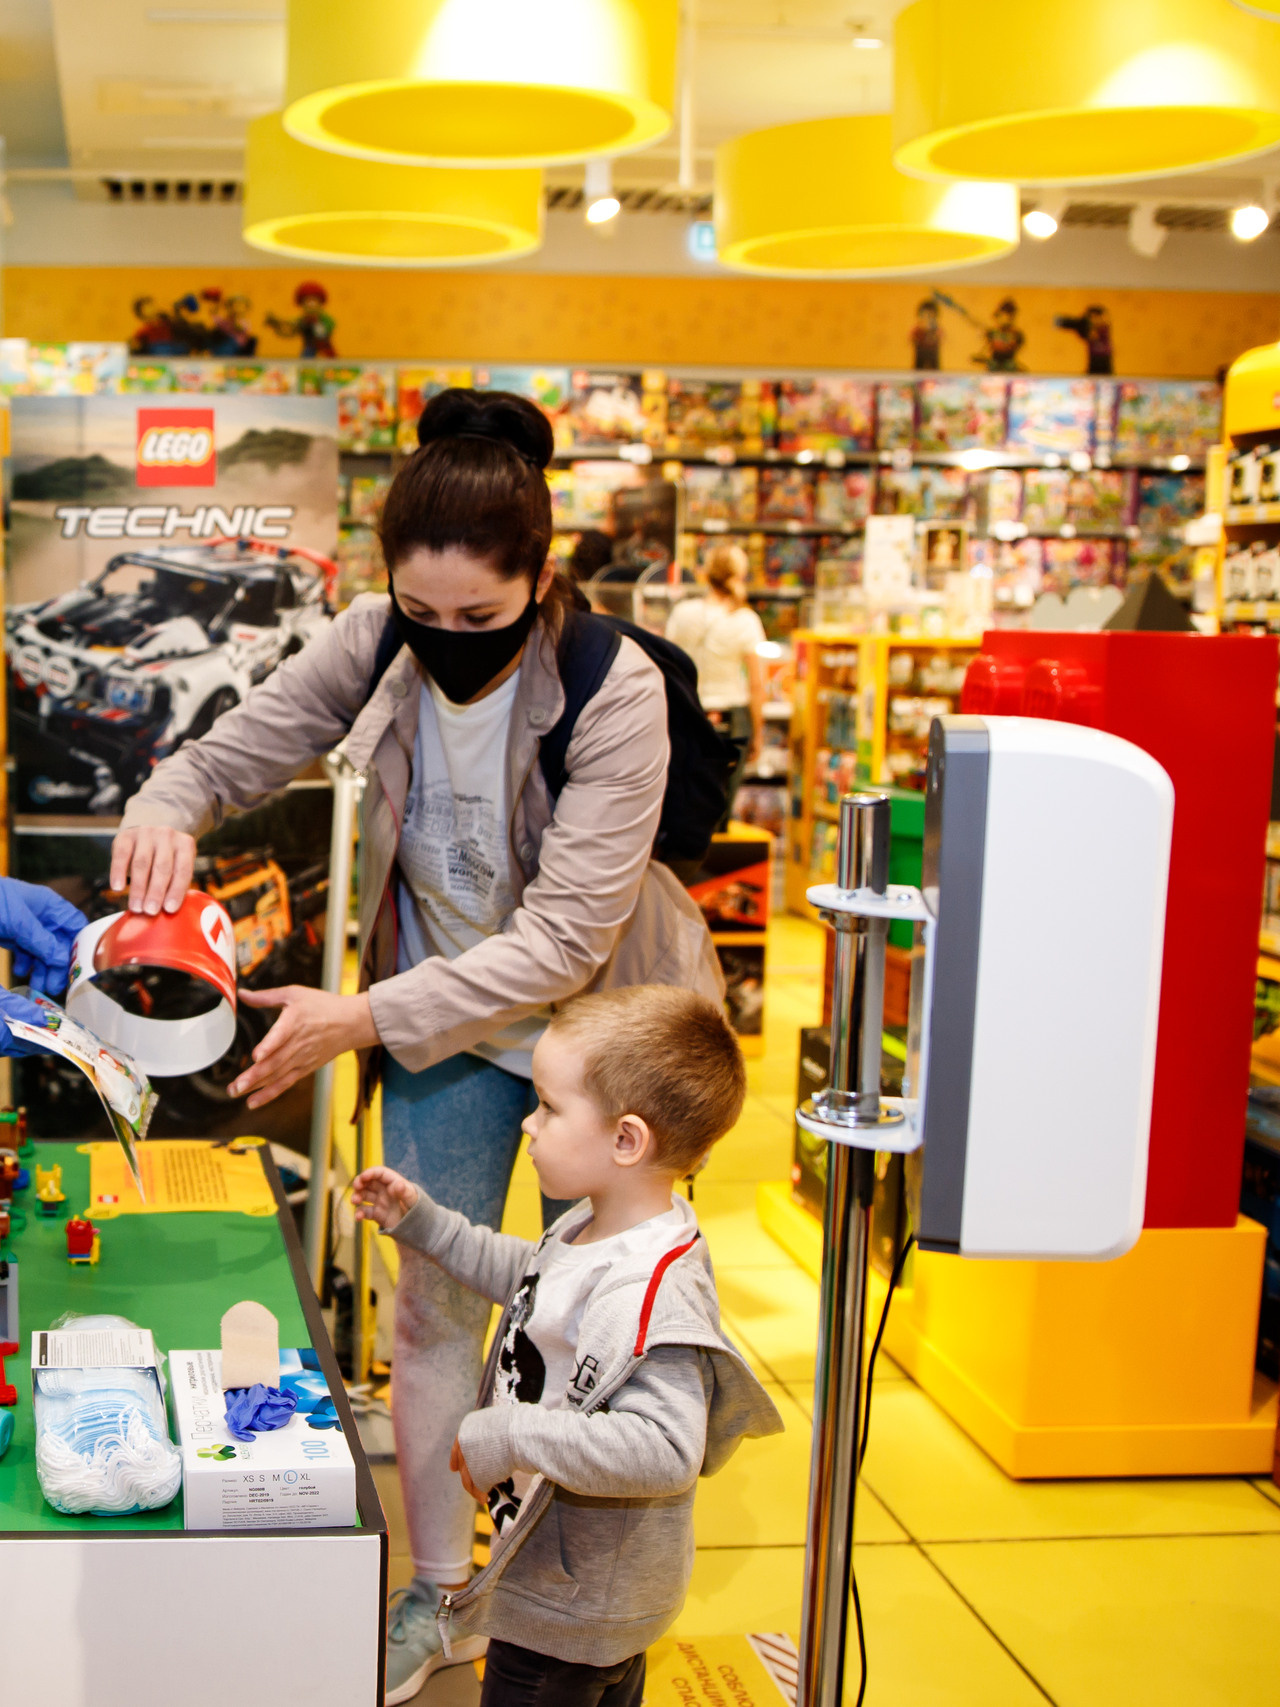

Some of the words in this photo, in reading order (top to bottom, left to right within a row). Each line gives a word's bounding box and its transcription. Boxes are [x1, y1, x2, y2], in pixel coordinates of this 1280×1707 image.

[138, 426, 214, 467] LEGO
[56, 505, 295, 538] TECHNIC
[190, 1396, 215, 1440] Перчатки
[300, 1440, 331, 1461] 100
[243, 1475, 255, 1483] XS
[259, 1475, 265, 1483] S
[272, 1474, 281, 1482] M
[300, 1473, 311, 1481] XL
